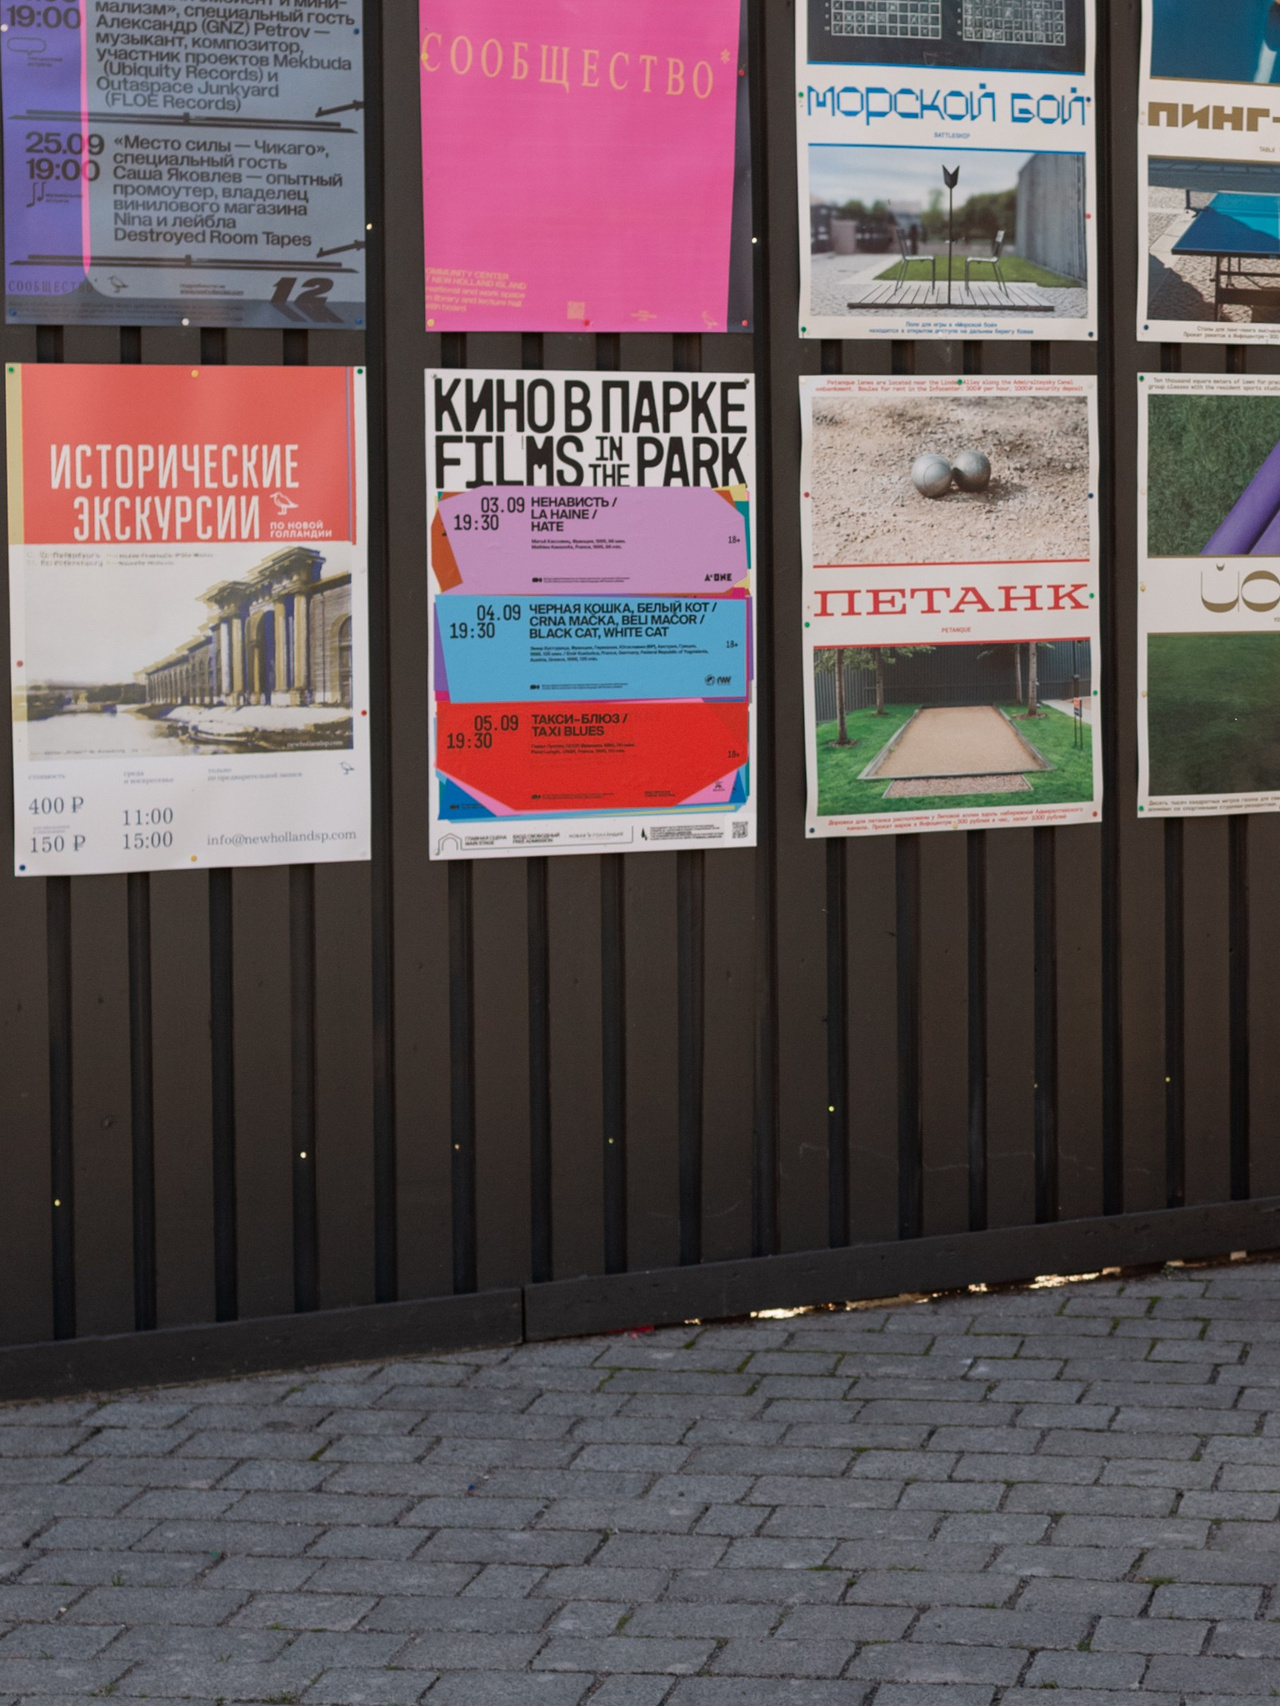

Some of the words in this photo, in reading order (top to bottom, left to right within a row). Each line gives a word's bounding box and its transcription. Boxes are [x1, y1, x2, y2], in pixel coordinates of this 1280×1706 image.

[7, 4, 81, 29] 19:00
[184, 5, 304, 25] специальный
[307, 13, 355, 26] гость
[96, 14, 198, 36] Александр
[201, 17, 250, 37] (GNZ)
[254, 22, 311, 38] Petrov
[95, 32, 189, 50] музыкант,
[191, 36, 304, 56] композитор,
[96, 48, 180, 64] участник
[185, 52, 270, 68] проектов
[273, 54, 352, 71] Mekbuda
[103, 59, 182, 81] (Ubiquity
[185, 64, 264, 83] Records)
[267, 72, 279, 83] и
[96, 76, 193, 97] Outaspace
[198, 80, 279, 99] Junkyard
[104, 92, 158, 109] (FLOE
[162, 94, 242, 113] Records)
[25, 131, 105, 156] 25.09
[113, 134, 182, 151] «Место
[185, 139, 231, 152] силы
[254, 139, 330, 158] Чикаго»,
[26, 157, 101, 182] 19:00
[113, 152, 235, 170] специальный
[238, 158, 287, 170] гость
[113, 165, 163, 181] Саша
[167, 167, 242, 183] Яковлев
[266, 173, 343, 187] опытный
[113, 183, 219, 200] промоутер,
[222, 188, 310, 204] владелец
[113, 199, 220, 213] винилового
[224, 202, 308, 217] магазина
[114, 214, 153, 227] Nina
[156, 217, 168, 227] и
[172, 215, 237, 229] лейбла
[114, 227, 206, 246] Destroyed
[210, 231, 258, 245] Room
[262, 231, 312, 248] Tapes
[434, 378, 555, 434] КИНО
[564, 379, 593, 434] В
[601, 379, 748, 434] ПАРКЕ
[595, 436, 623, 461] IN
[51, 444, 299, 490] ИСТОРИЧЕСКИЕ
[435, 434, 584, 489] FILMS
[636, 436, 748, 488] PARK
[588, 464, 630, 487] THE
[480, 497, 525, 514] 03.09
[531, 497, 610, 508] НЕНАВИСТЬ
[73, 496, 260, 541] ЭКСКУРСИИ
[453, 514, 500, 531] 19:30
[531, 509, 548, 519] LA
[550, 509, 590, 519] HAINE
[270, 522, 285, 530] ПО
[288, 519, 324, 530] НОВОЙ
[270, 529, 332, 538] ГОЛЛАНДИИ
[531, 521, 564, 532] HATE
[728, 535, 741, 544] 18+
[529, 603, 581, 614] ЧЕРНАЯ
[584, 603, 635, 616] КОШКА,
[637, 600, 682, 613] БЕЛЫЙ
[685, 602, 710, 613] КОТ
[813, 584, 1089, 617] ПЕТАНК
[477, 604, 521, 621] 04.09
[529, 615, 566, 626] CRNA
[622, 614, 648, 625] BELI
[449, 623, 496, 639] 19:30
[529, 628, 573, 639] BLACK
[575, 627, 601, 640] CAT,
[604, 627, 643, 638] WHITE
[645, 627, 669, 638] CAT
[726, 640, 739, 649] 18+
[474, 715, 519, 731] 05.09
[531, 713, 620, 725] ТАКСИ-БЛЮЗ
[446, 732, 493, 749] 19:30
[532, 726, 561, 737] TAXI
[564, 726, 605, 737] BLUES
[28, 797, 65, 815] 400
[123, 807, 174, 826] 11:00
[31, 835, 65, 853] 150
[123, 831, 173, 850] 15:00
[207, 829, 357, 847] info@newhollandsp.com
